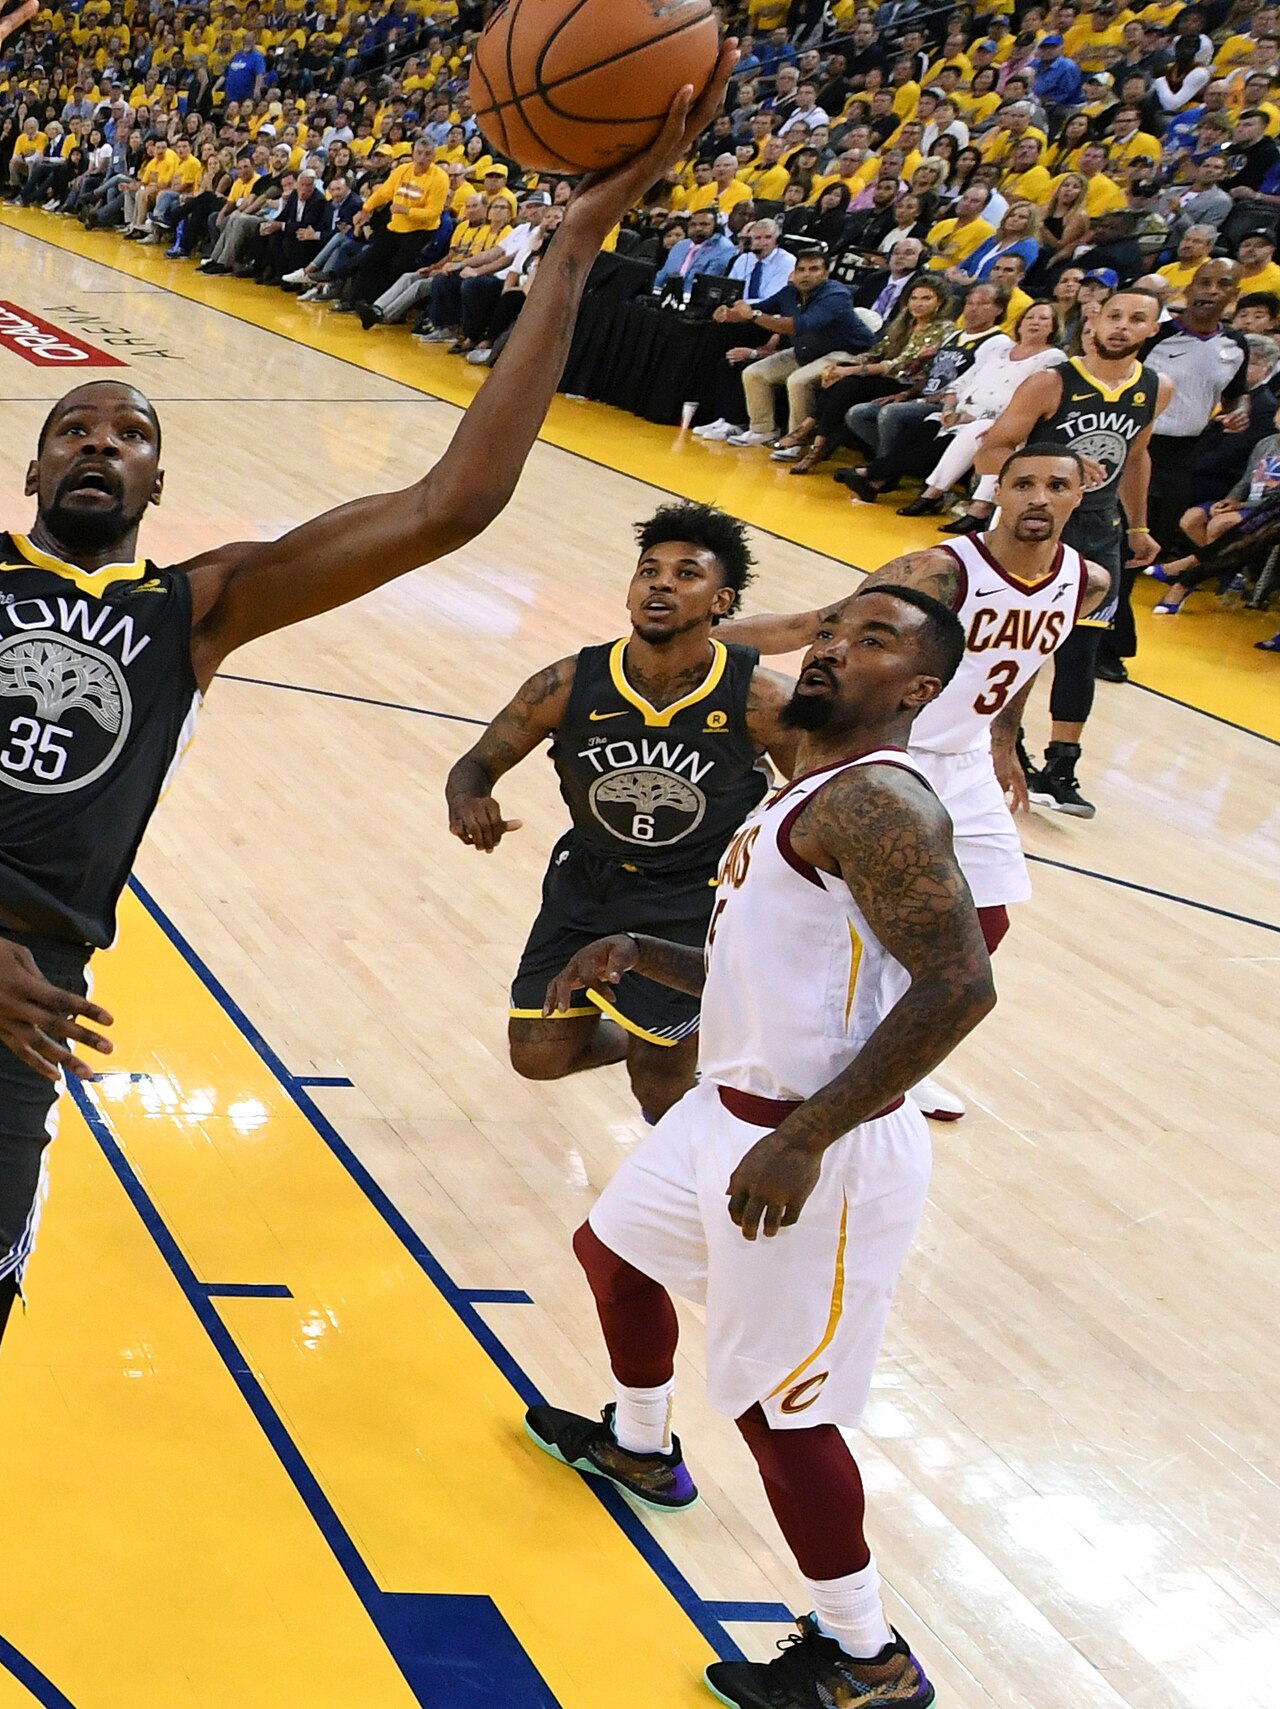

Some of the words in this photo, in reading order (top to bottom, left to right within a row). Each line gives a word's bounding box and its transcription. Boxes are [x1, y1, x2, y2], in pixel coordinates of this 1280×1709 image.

[43, 305, 185, 360] ARENA
[1056, 412, 1142, 440] TOWN
[966, 607, 1065, 655] CAVS
[973, 660, 1020, 715] 3
[0, 716, 74, 781] 35
[577, 738, 715, 784] TOWN
[631, 814, 655, 840] 6
